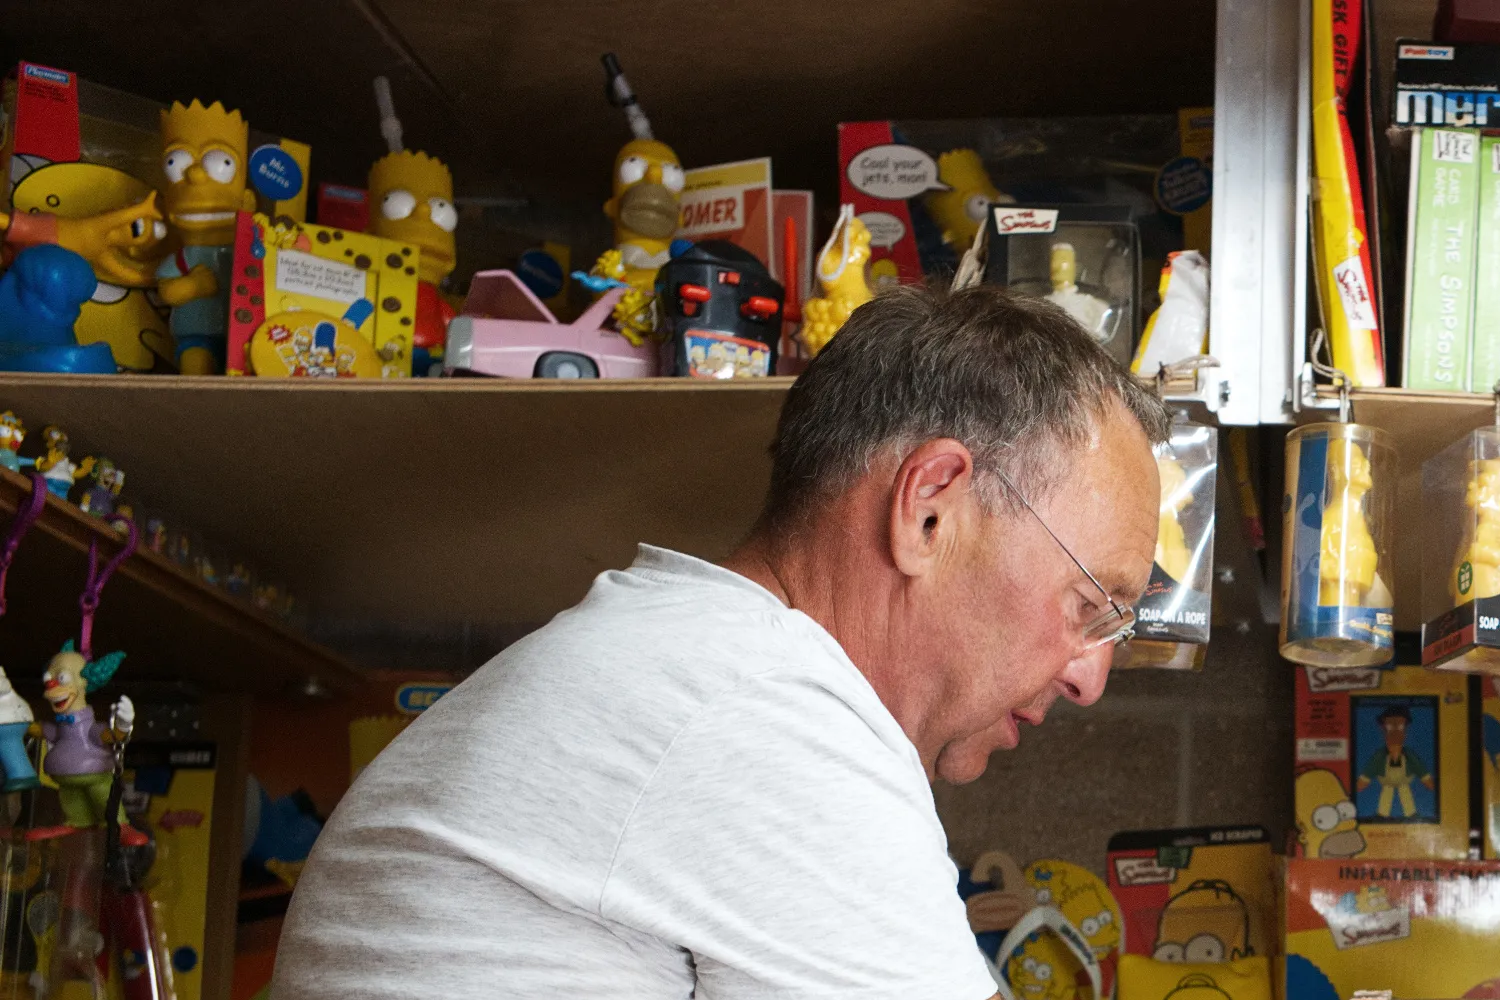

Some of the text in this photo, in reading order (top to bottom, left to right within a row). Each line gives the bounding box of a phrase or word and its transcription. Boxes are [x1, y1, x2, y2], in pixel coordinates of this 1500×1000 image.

[1334, 34, 1348, 76] GIFT
[269, 156, 287, 175] Mr.
[893, 160, 923, 172] your
[1433, 167, 1446, 208] GAME
[1448, 168, 1462, 205] CARD
[683, 196, 737, 228] OMER
[1434, 220, 1465, 383] THE SIMPSONS
[1138, 607, 1161, 621] SOAP
[1177, 611, 1184, 624] A
[1185, 611, 1207, 625] ROPE
[1479, 615, 1500, 631] SOAP
[1338, 866, 1443, 883] INFLATABLE
